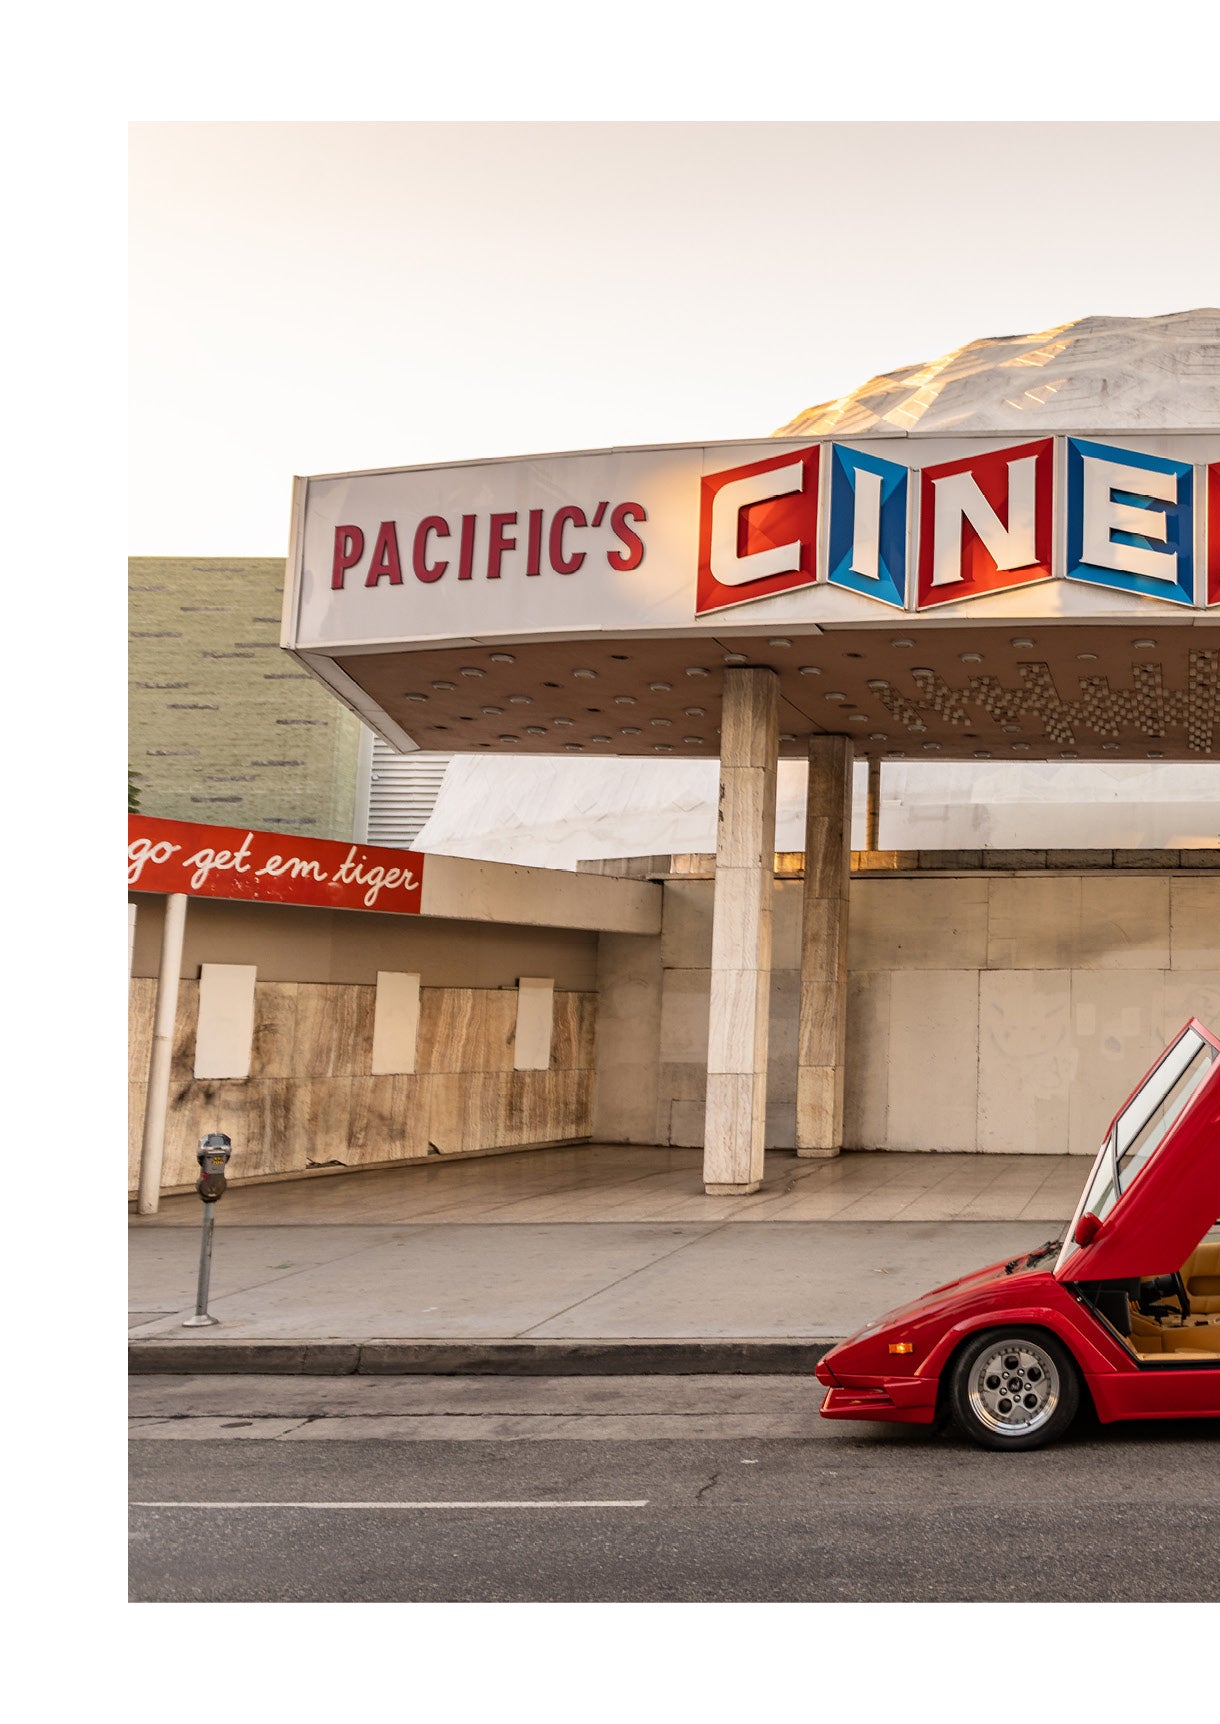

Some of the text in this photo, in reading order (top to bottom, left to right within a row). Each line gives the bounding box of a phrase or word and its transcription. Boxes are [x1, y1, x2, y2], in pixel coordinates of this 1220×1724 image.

[331, 501, 648, 591] PACIFIC'S
[128, 832, 419, 907] go get em tiger
